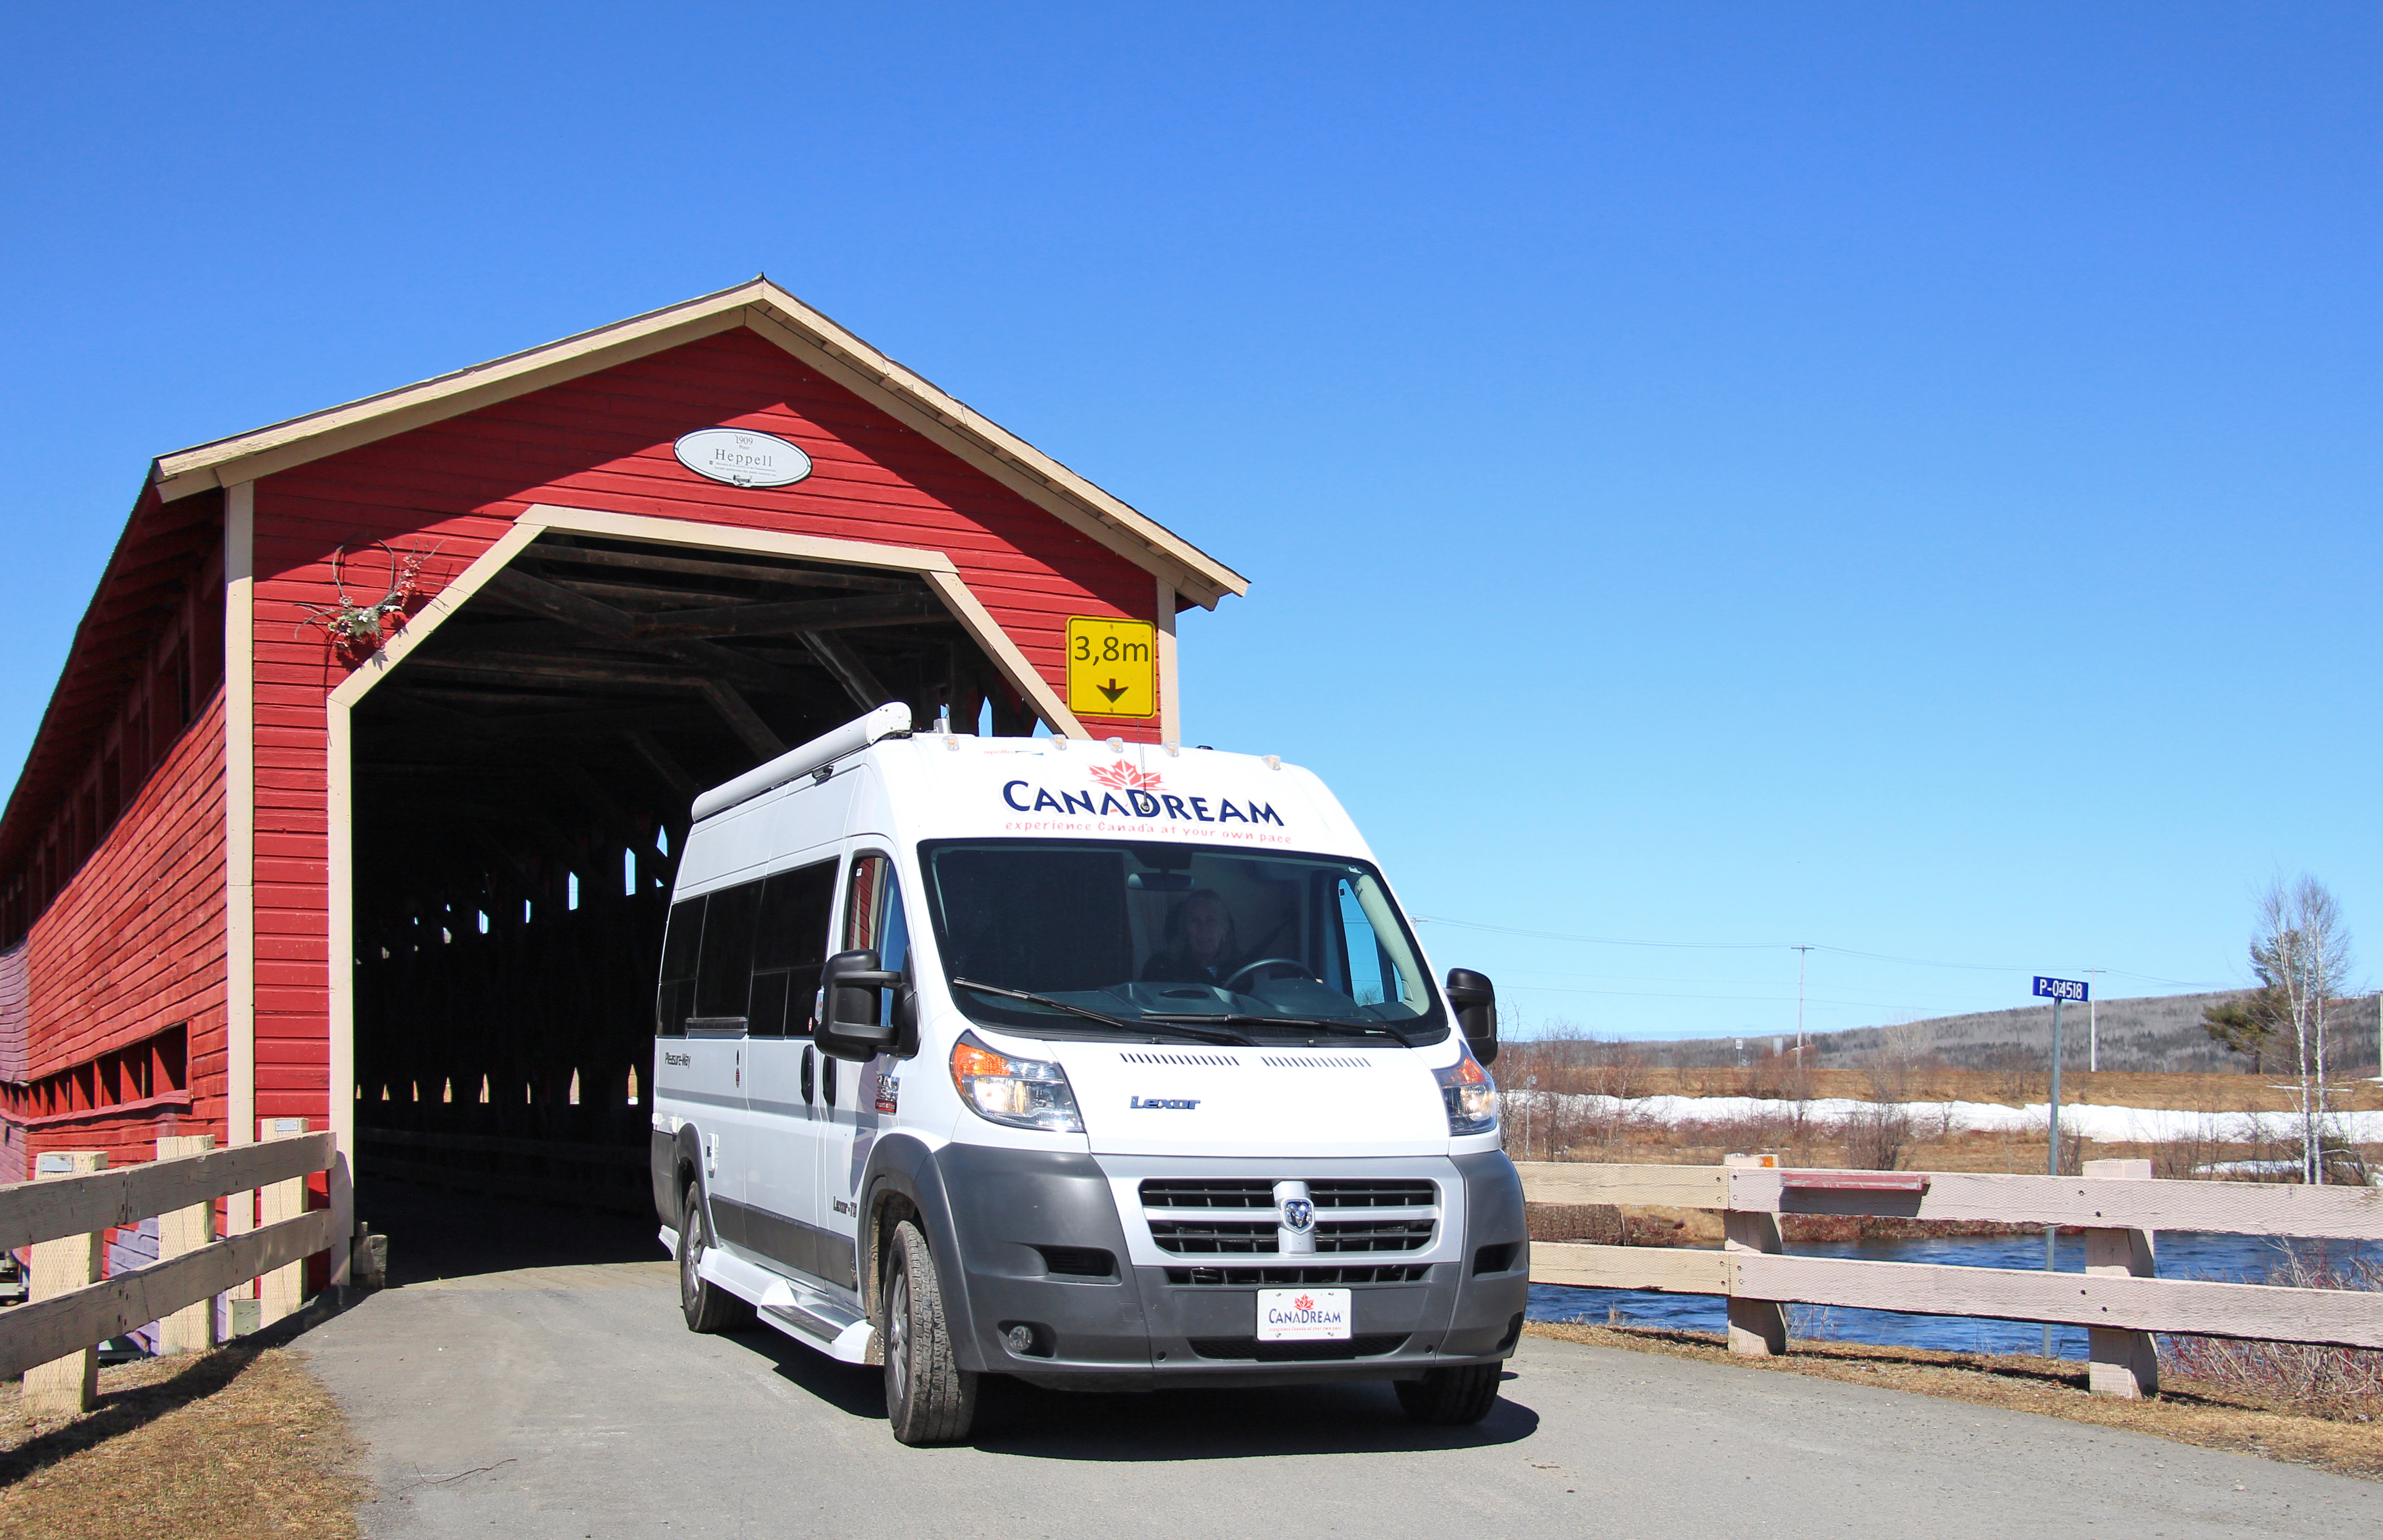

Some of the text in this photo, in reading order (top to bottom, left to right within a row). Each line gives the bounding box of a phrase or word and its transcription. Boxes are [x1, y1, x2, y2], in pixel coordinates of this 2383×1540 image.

[734, 434, 753, 445] 1909
[715, 448, 772, 467] Heppell
[1075, 636, 1148, 666] 3,8m
[1005, 820, 1291, 844] experience Canada at your own pace
[2039, 978, 2083, 1000] P-04518
[1130, 1095, 1201, 1109] Lexor
